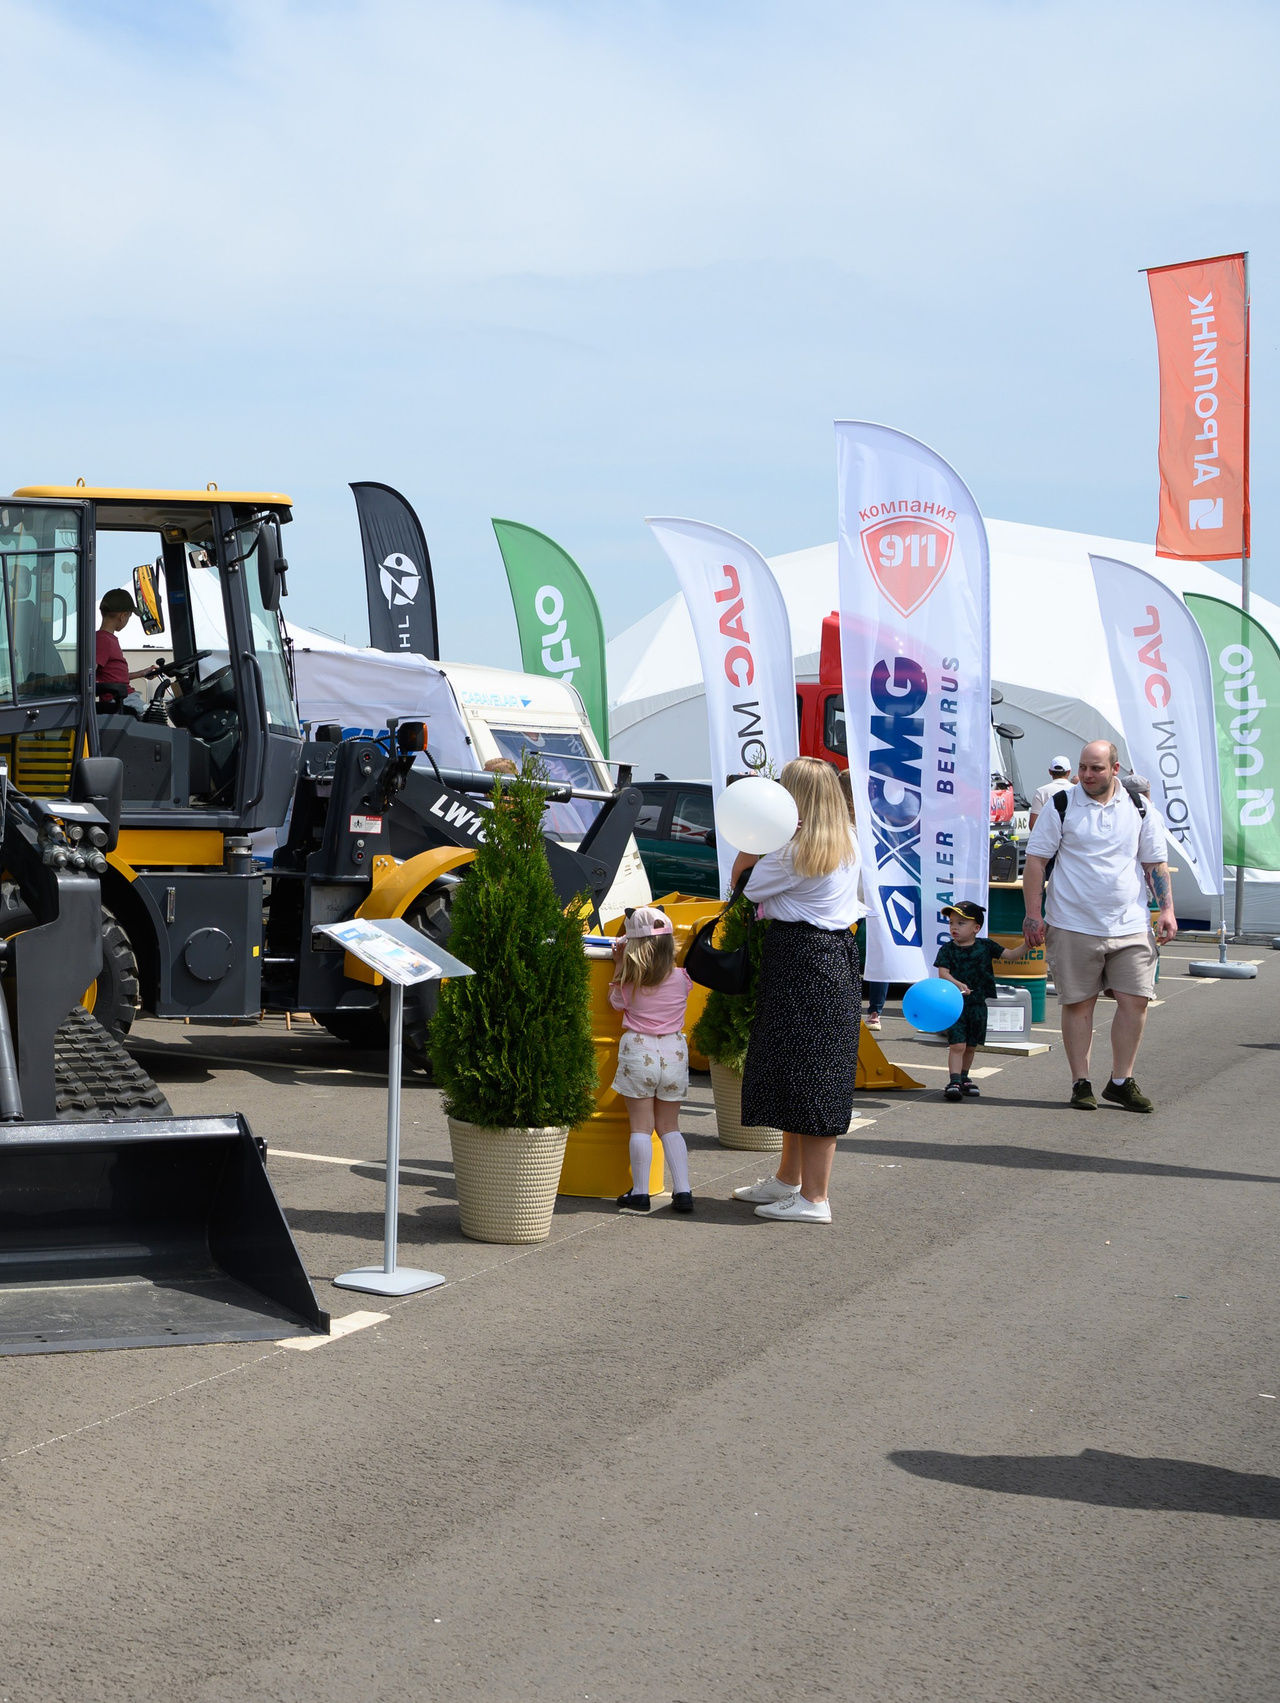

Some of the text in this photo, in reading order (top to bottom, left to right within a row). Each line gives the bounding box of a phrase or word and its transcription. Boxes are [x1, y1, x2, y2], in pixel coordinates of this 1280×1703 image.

[858, 500, 957, 523] компания
[878, 533, 937, 568] 911
[398, 615, 411, 648] HL
[936, 656, 960, 795] BELARUS
[868, 656, 928, 885] XCMG
[429, 794, 500, 845] LW1
